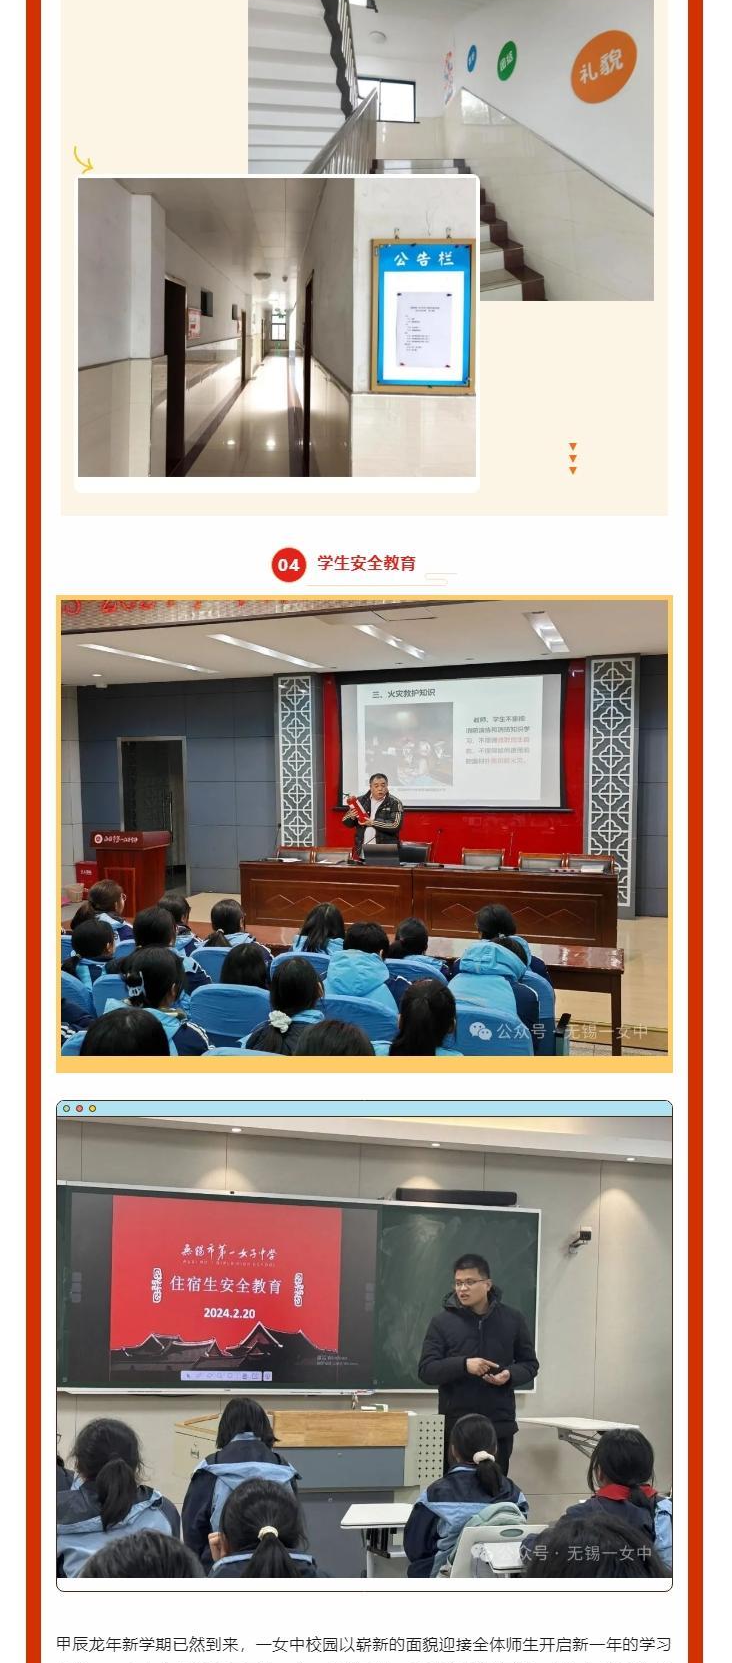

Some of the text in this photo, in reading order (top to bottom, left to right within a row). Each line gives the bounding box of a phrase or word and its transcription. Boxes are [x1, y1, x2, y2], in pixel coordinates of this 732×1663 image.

[580, 50, 624, 87] 礼貌
[393, 251, 455, 267] 公告栏
[278, 555, 416, 572] 04 学生安全教育
[372, 688, 436, 699] 三、火灾救护知识
[169, 1275, 282, 1295] 住宿生安全教育
[204, 1307, 256, 1319] 2024.2.20
[57, 1636, 670, 1652] 甲辰龙年新学期已然到来，一女中校园以崭新的面貌迎接全体师生开启新一年的学习
